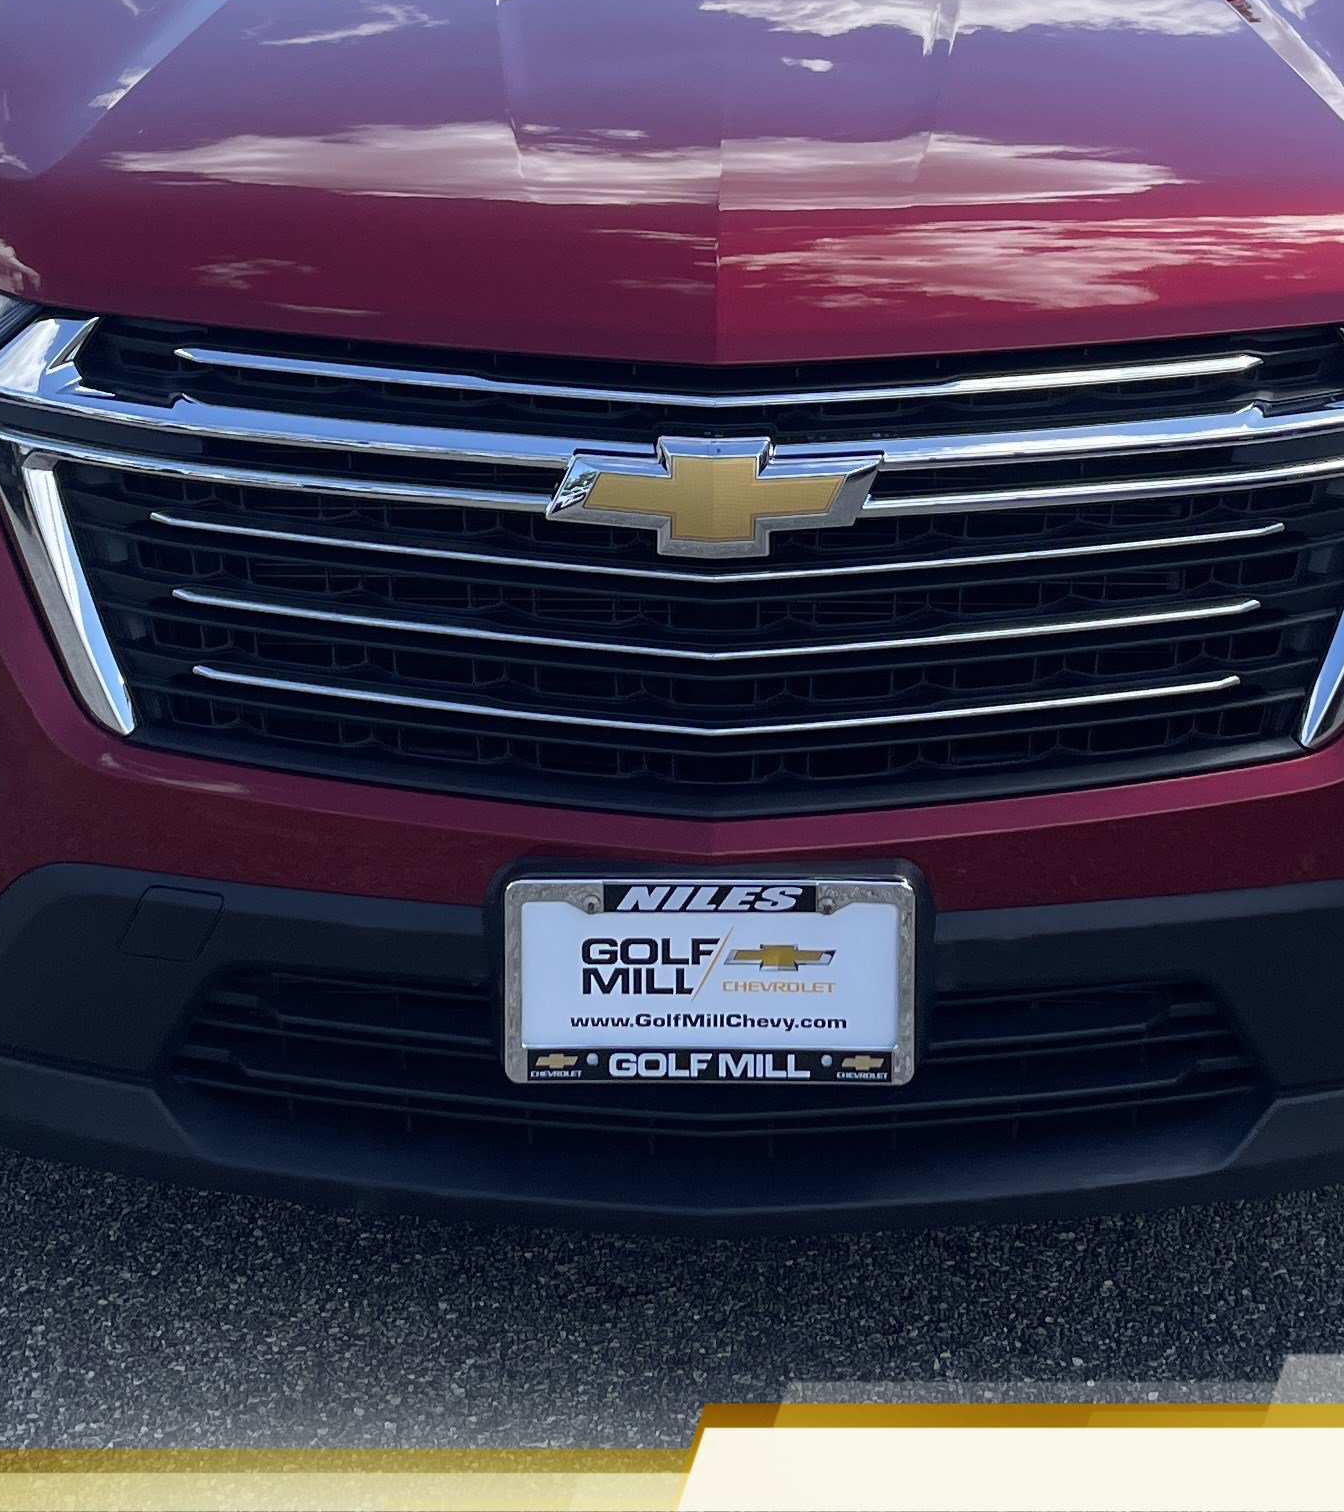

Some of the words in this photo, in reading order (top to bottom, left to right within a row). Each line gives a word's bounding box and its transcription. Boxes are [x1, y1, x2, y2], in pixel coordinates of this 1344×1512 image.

[616, 885, 803, 912] NILES
[581, 937, 721, 966] GOLF
[582, 967, 694, 996] MILL
[721, 979, 837, 994] CHEVROLET
[570, 1013, 847, 1032] www.GolfMillChevy.com
[530, 1069, 582, 1078] CHEVROLET
[608, 1052, 712, 1079] GOLF
[718, 1053, 811, 1079] MILL
[836, 1070, 888, 1079] CHEVROLET
